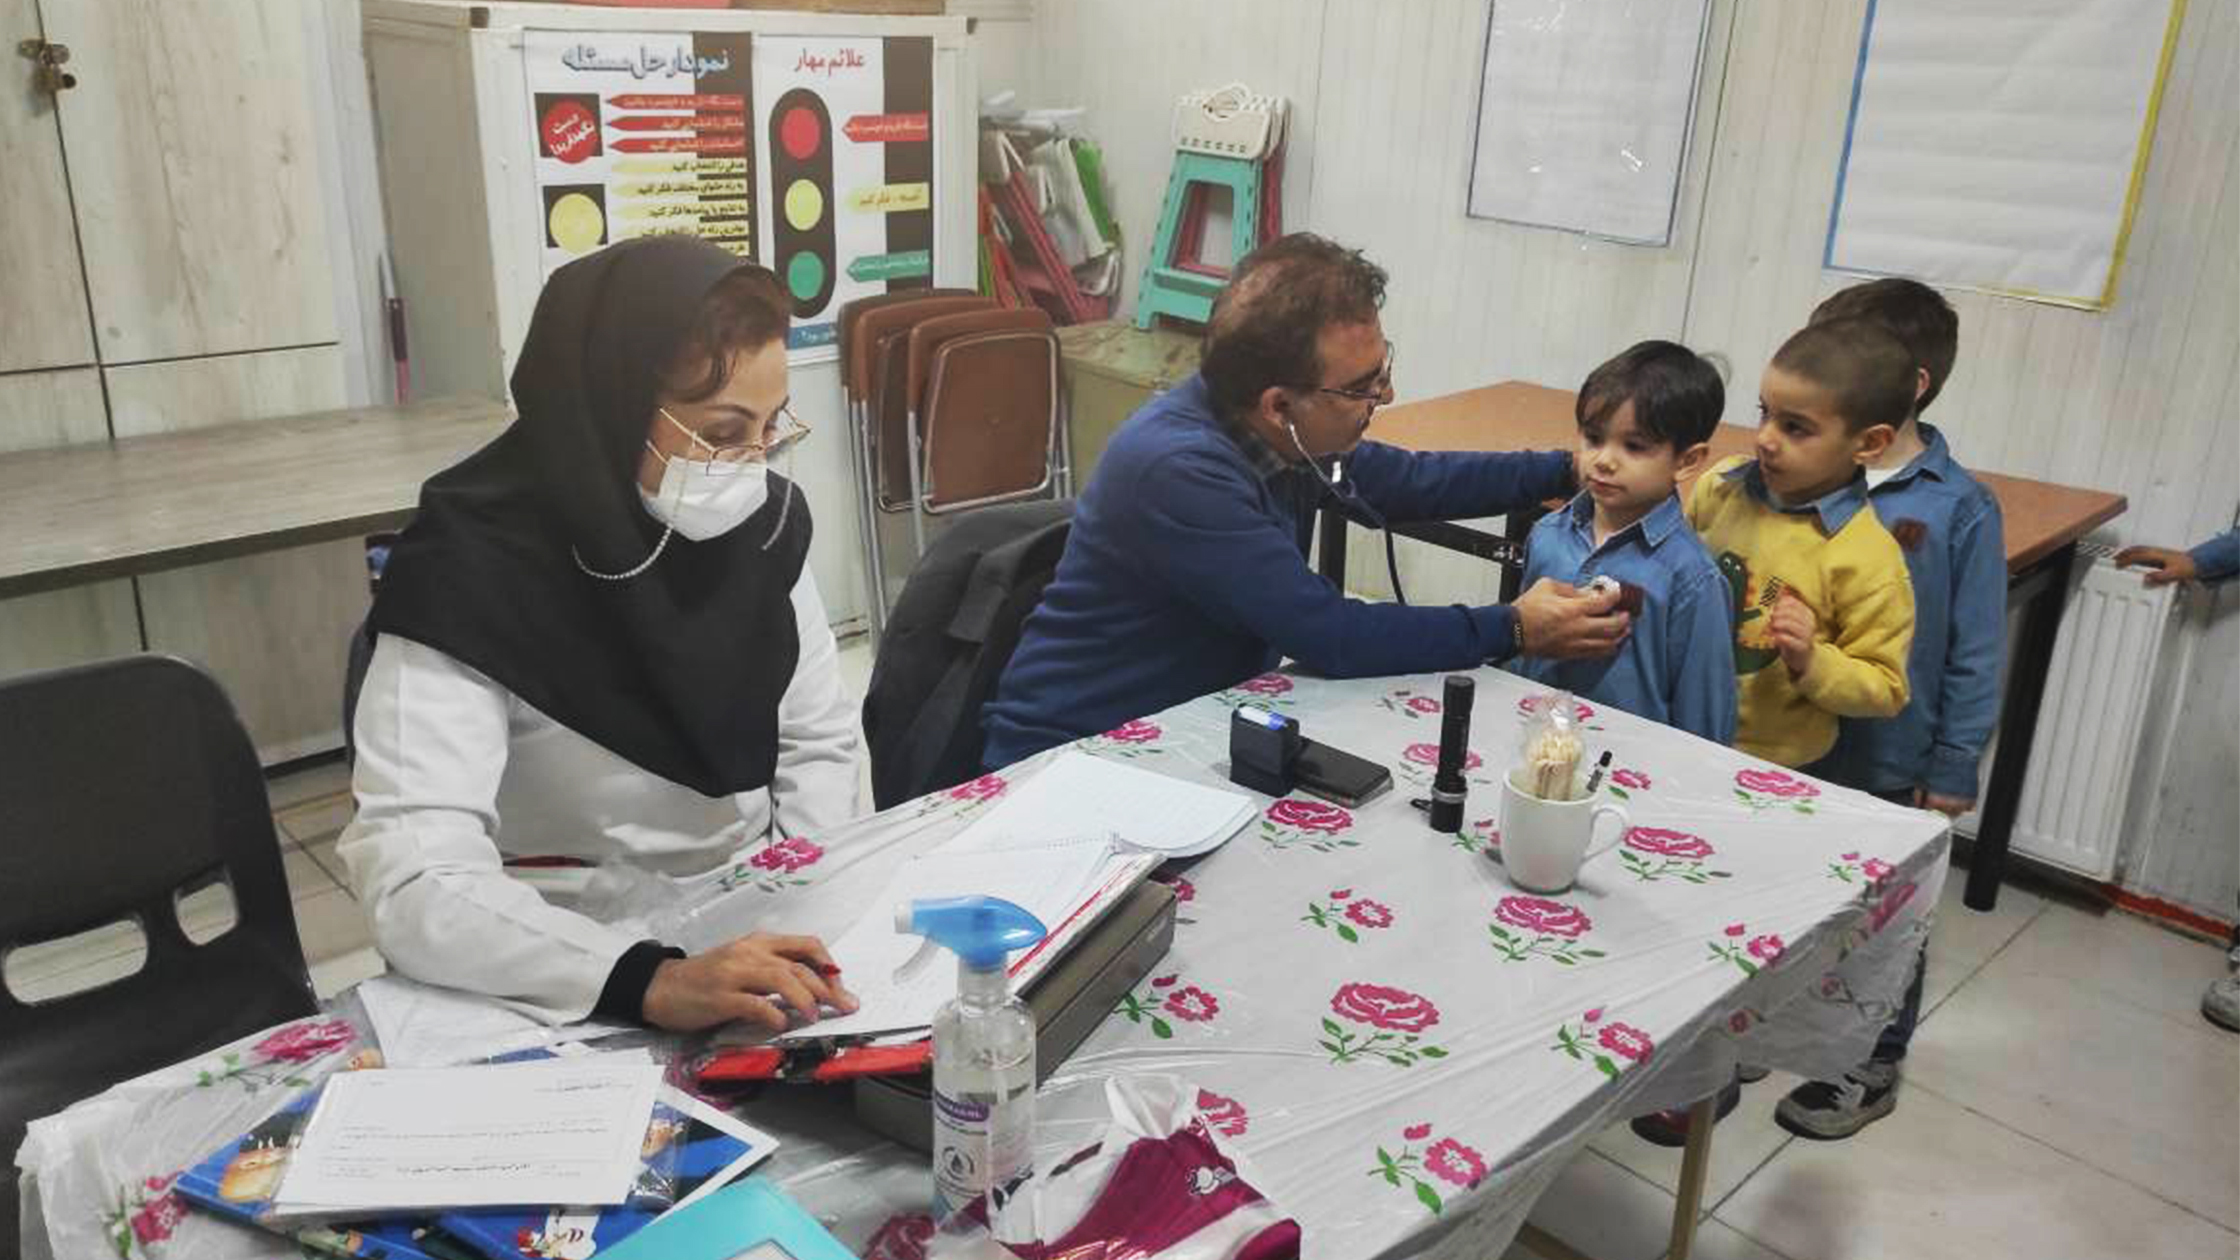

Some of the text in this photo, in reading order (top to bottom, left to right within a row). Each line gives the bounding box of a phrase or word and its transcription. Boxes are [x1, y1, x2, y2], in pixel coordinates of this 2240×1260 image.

[630, 45, 667, 79] حل
[666, 45, 730, 79] نمودار
[793, 47, 864, 78] علائم مهار
